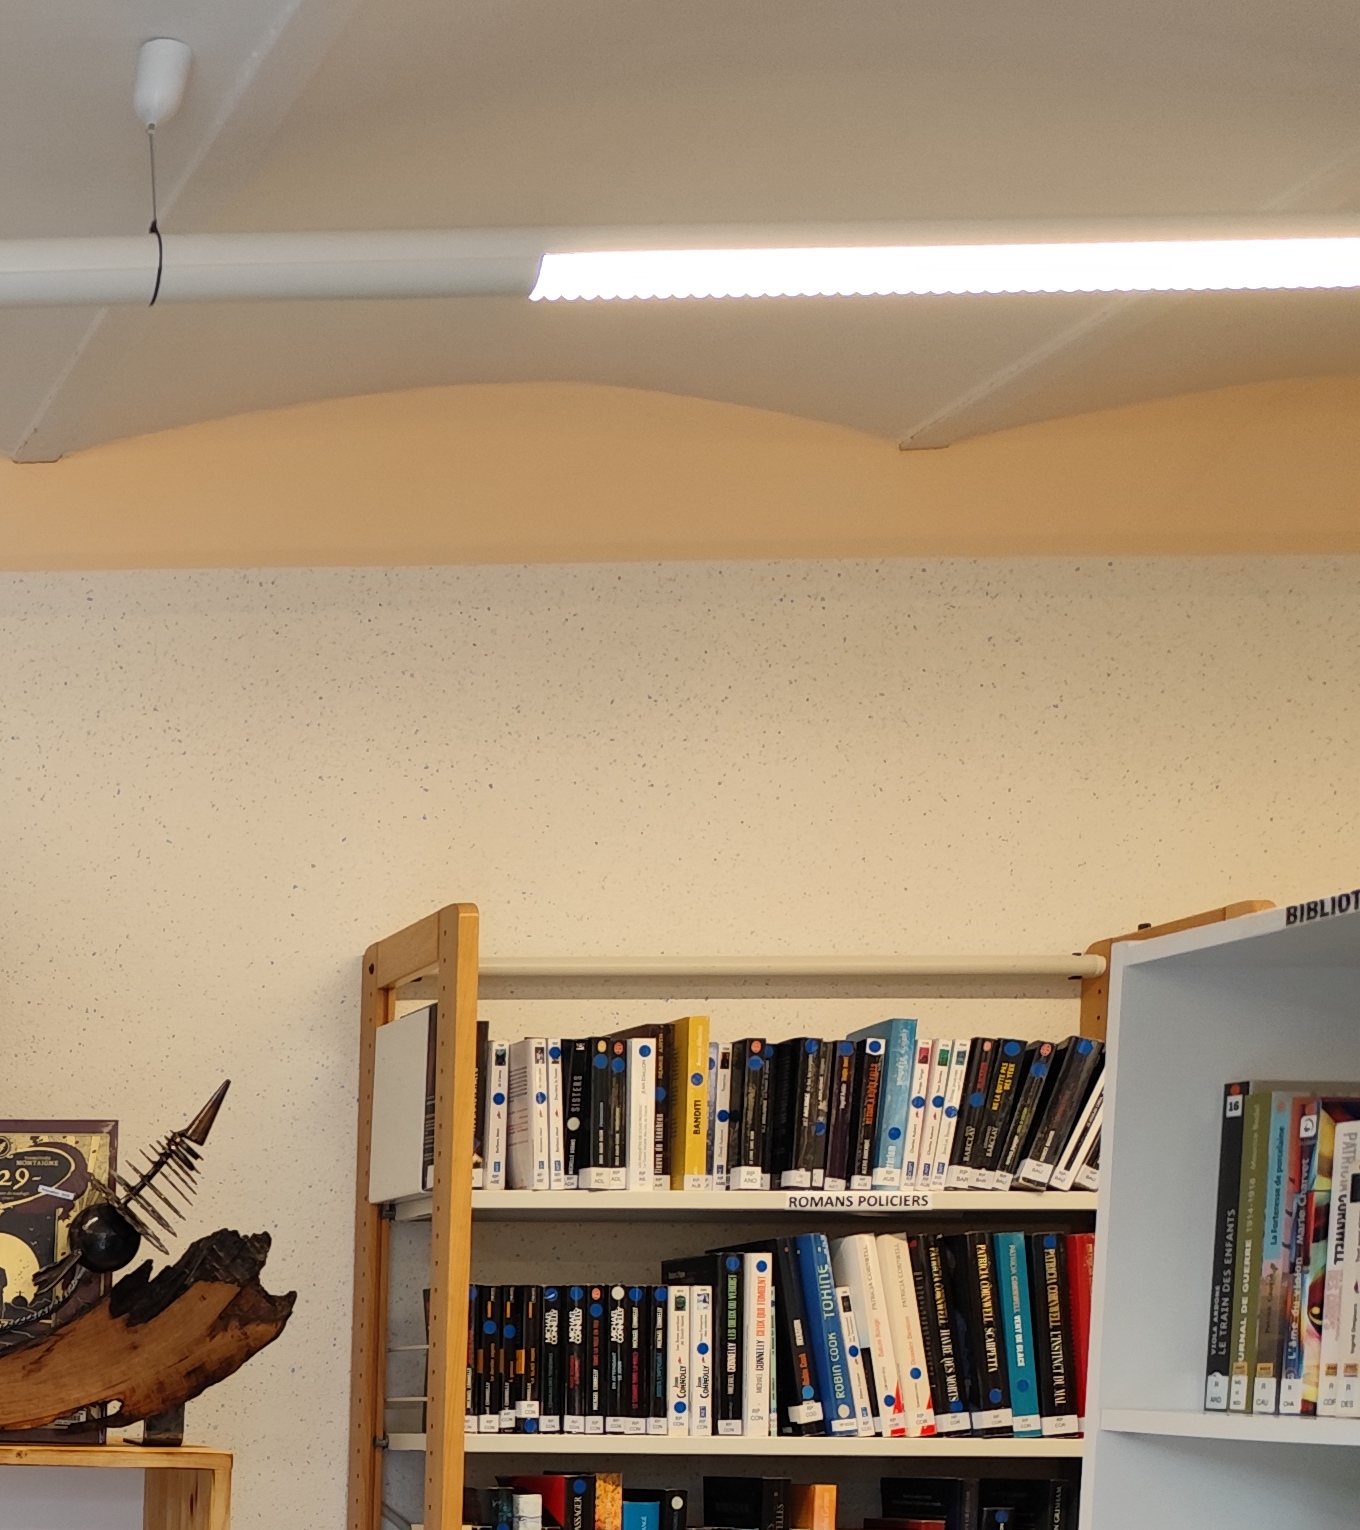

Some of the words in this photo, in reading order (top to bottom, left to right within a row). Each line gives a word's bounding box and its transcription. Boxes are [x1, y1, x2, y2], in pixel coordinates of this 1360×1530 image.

[570, 1075, 584, 1113] SISTERS
[1228, 1101, 1240, 1112] 16
[692, 1100, 702, 1135] BANDITI
[963, 1127, 976, 1162] BARCLAY
[986, 1126, 999, 1158] BARCLAY
[1271, 1198, 1281, 1234] Forteresse
[1277, 1126, 1285, 1173] porcelaine
[789, 1195, 854, 1208] ROMANS
[858, 1194, 928, 1207] POLICIERS
[1224, 1208, 1236, 1265] ENFANTS
[975, 1244, 989, 1280] PATRICIA
[1044, 1248, 1058, 1284] PATRICIA
[1242, 1239, 1252, 1294] GUERRE
[756, 1276, 766, 1305] TOMBENT
[1222, 1270, 1231, 1294] DES
[979, 1280, 994, 1324] CORNWELL
[1046, 1284, 1061, 1329] CORNWELL
[1241, 1296, 1249, 1314] DE
[1219, 1305, 1230, 1340] TRAIN
[829, 1331, 841, 1362] COOK
[983, 1327, 999, 1373] SCARPETTA
[1218, 1341, 1227, 1355] LE
[832, 1363, 846, 1399] ROBIN
